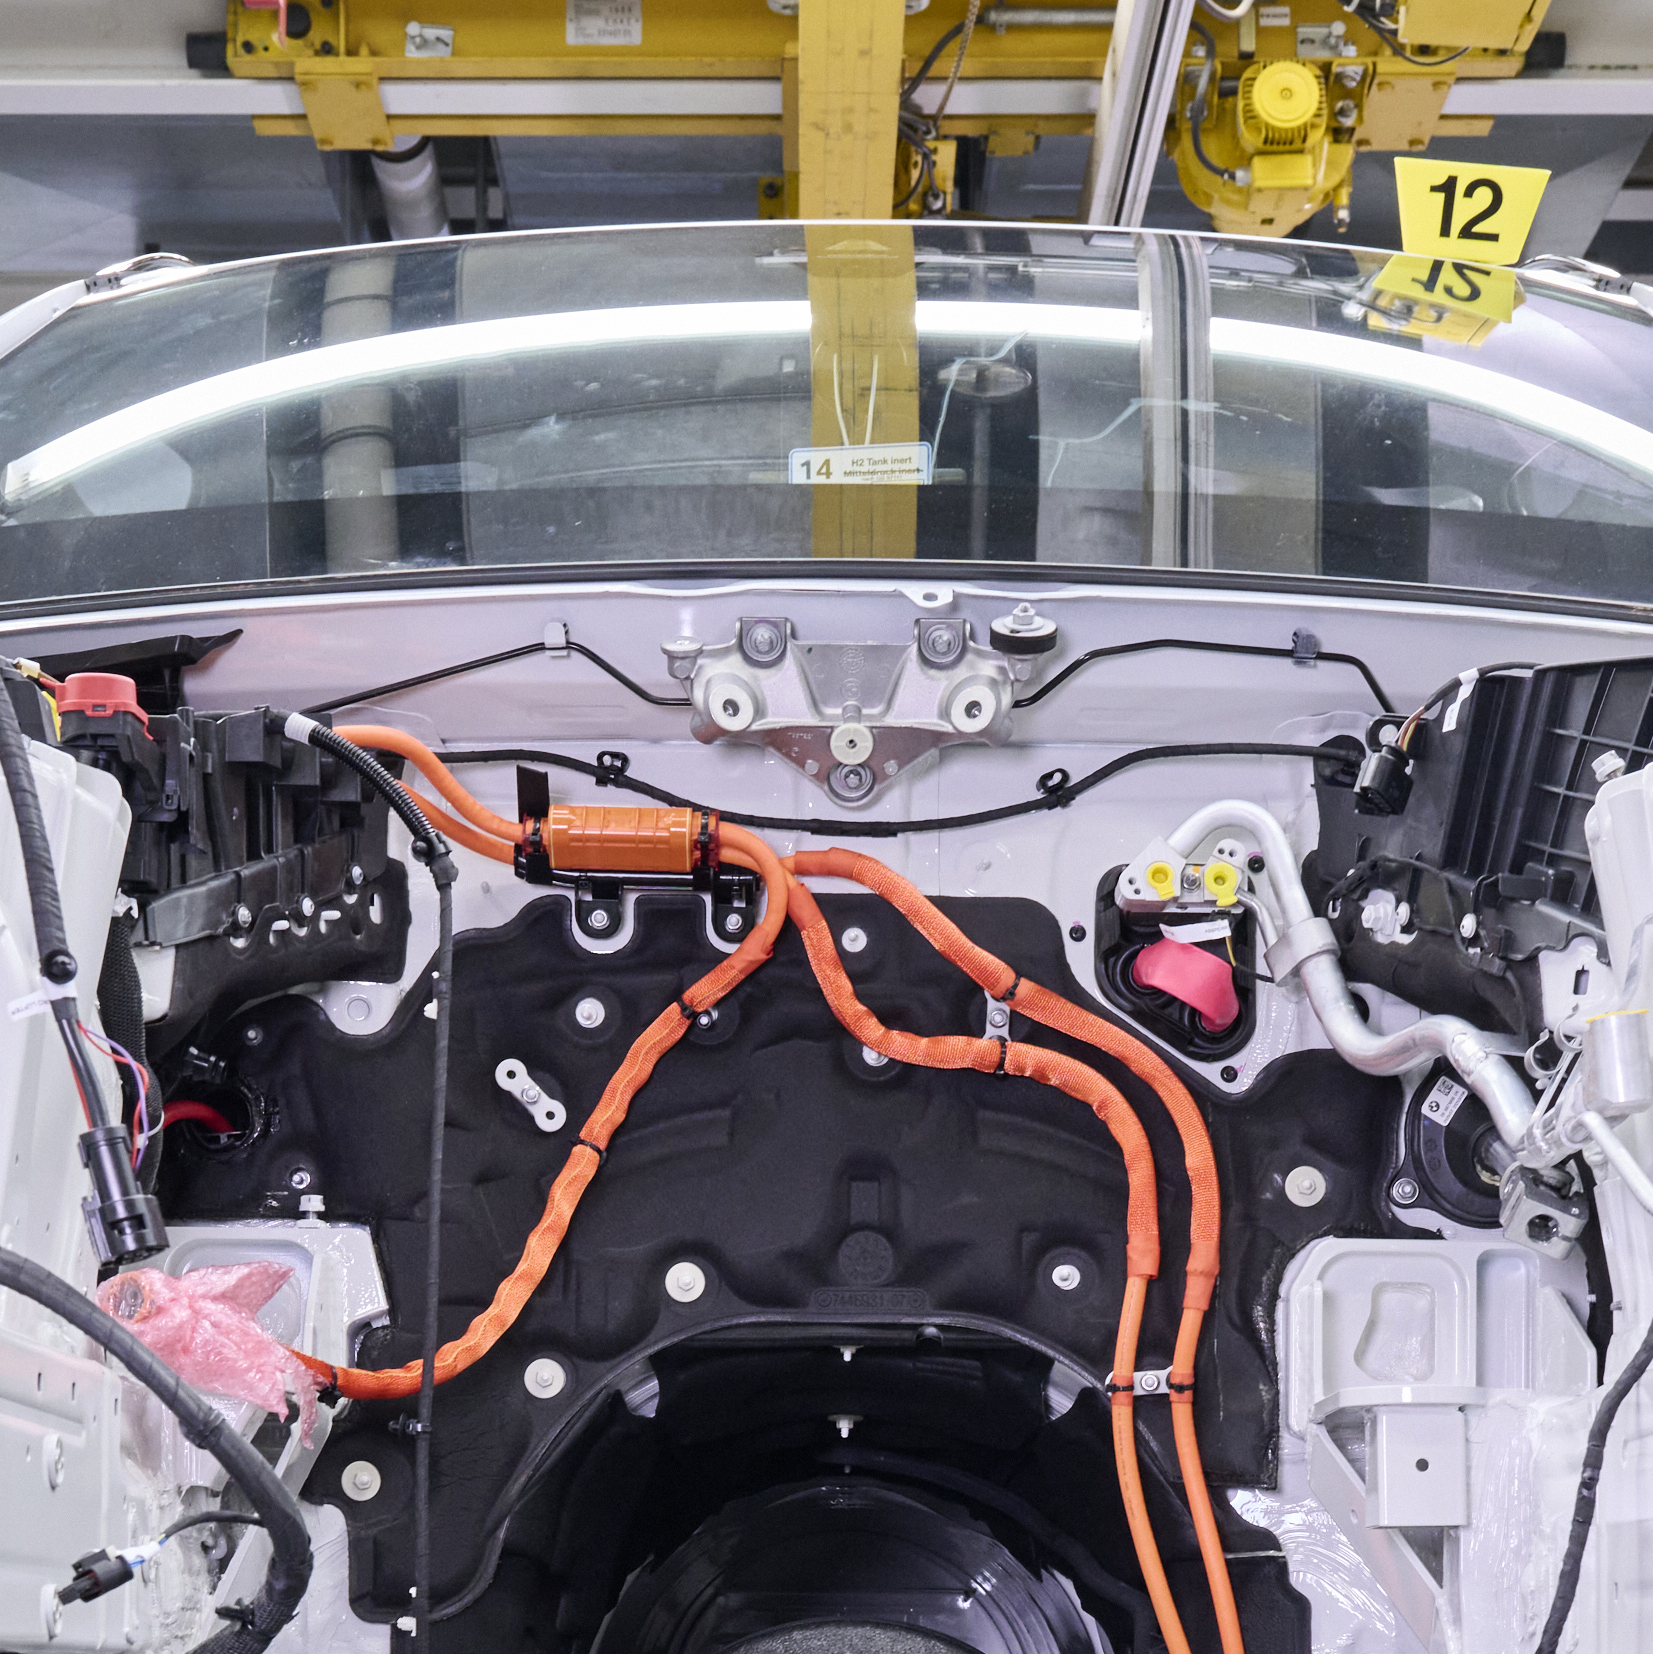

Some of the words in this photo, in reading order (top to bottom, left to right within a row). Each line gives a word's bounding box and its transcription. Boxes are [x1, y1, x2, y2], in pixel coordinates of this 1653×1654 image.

[1429, 175, 1503, 242] 12
[800, 459, 833, 480] 14
[851, 459, 865, 467] H2
[868, 458, 889, 466] Tank
[890, 456, 913, 464] inert
